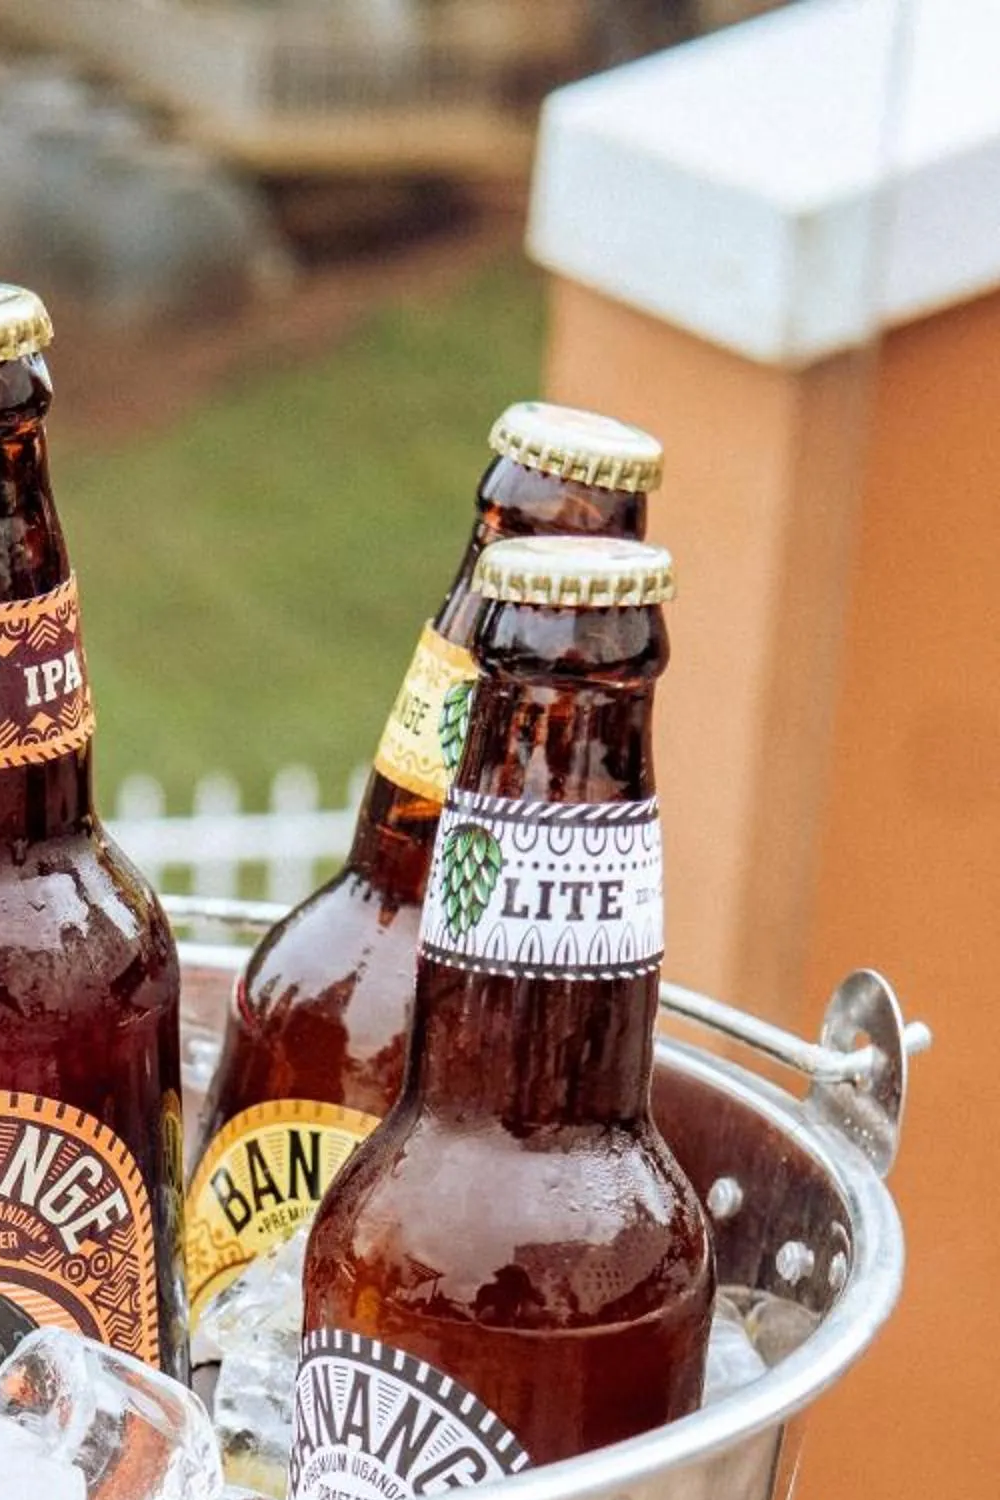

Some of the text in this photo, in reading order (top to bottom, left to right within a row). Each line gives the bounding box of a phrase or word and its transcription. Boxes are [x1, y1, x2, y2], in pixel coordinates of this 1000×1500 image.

[24, 649, 83, 708] IPA
[501, 877, 624, 922] LITE
[210, 1129, 362, 1235] BAN
